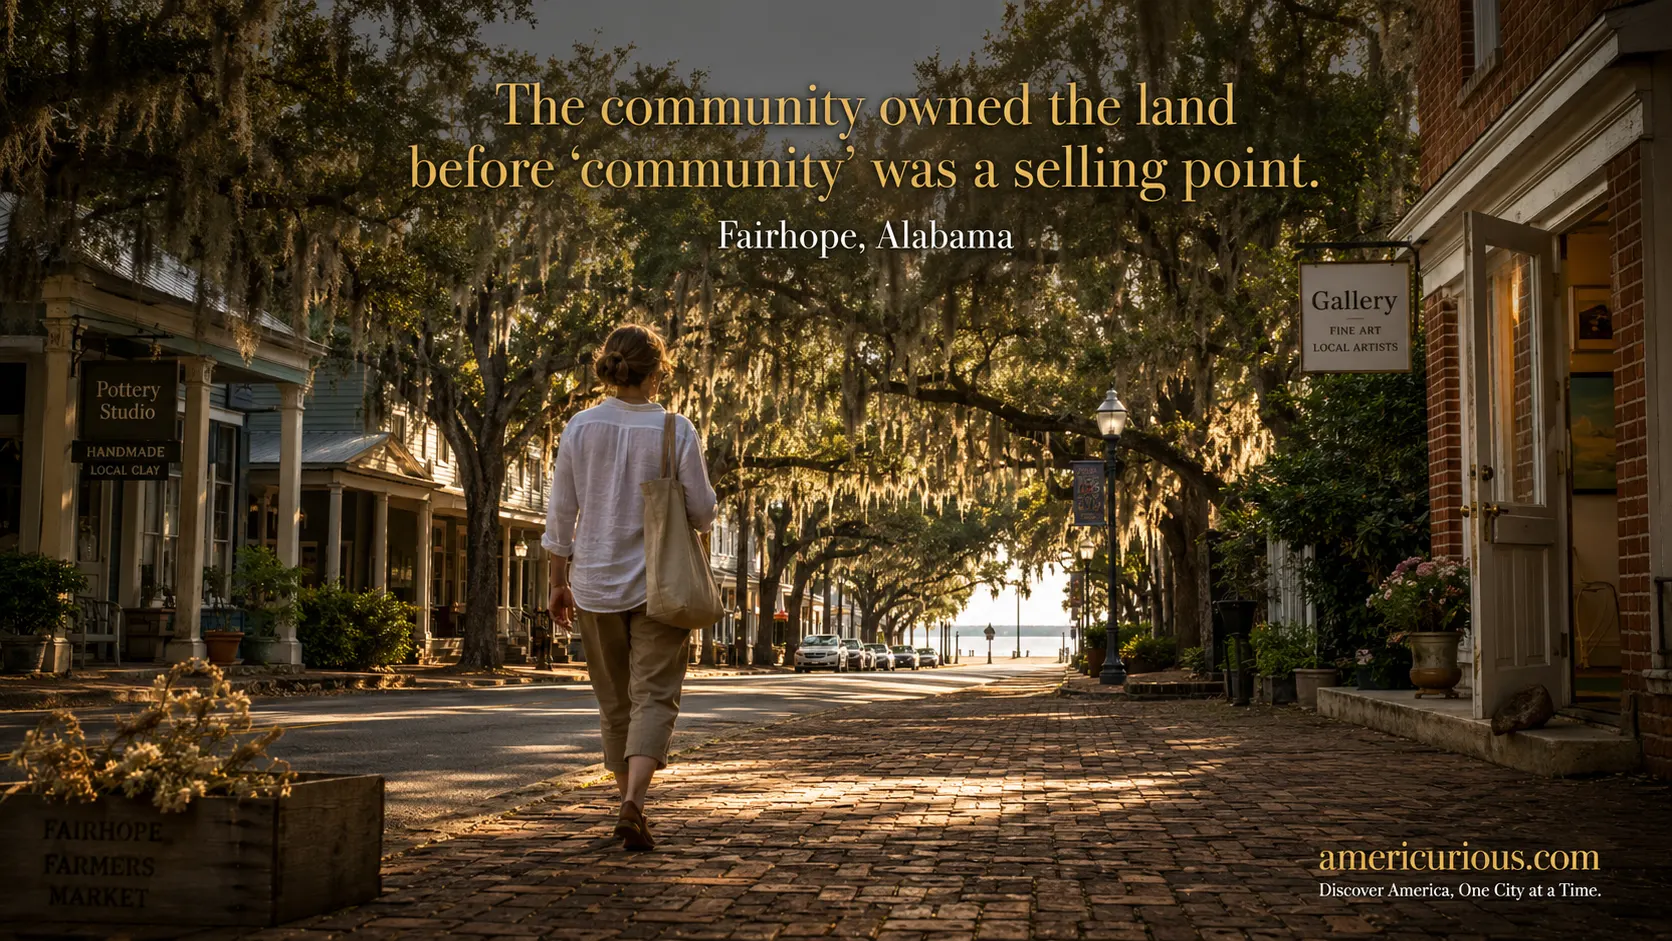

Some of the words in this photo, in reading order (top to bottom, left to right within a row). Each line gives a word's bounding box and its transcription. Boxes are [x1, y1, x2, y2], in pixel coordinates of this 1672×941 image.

[1311, 290, 1398, 316] Gallery
[1329, 326, 1356, 336] FINE
[1359, 325, 1382, 336] ART
[1312, 343, 1350, 353] LOCAL
[1352, 341, 1399, 353] ARTISTS
[96, 380, 161, 402] Pottery
[99, 403, 156, 421] Studio
[86, 446, 165, 459] HANDMADE
[90, 464, 128, 476] LOCAL
[131, 464, 161, 476] CLAY
[43, 818, 163, 842] FAIRHOPE
[43, 855, 156, 877] FARMERS
[48, 886, 149, 907] MARKET
